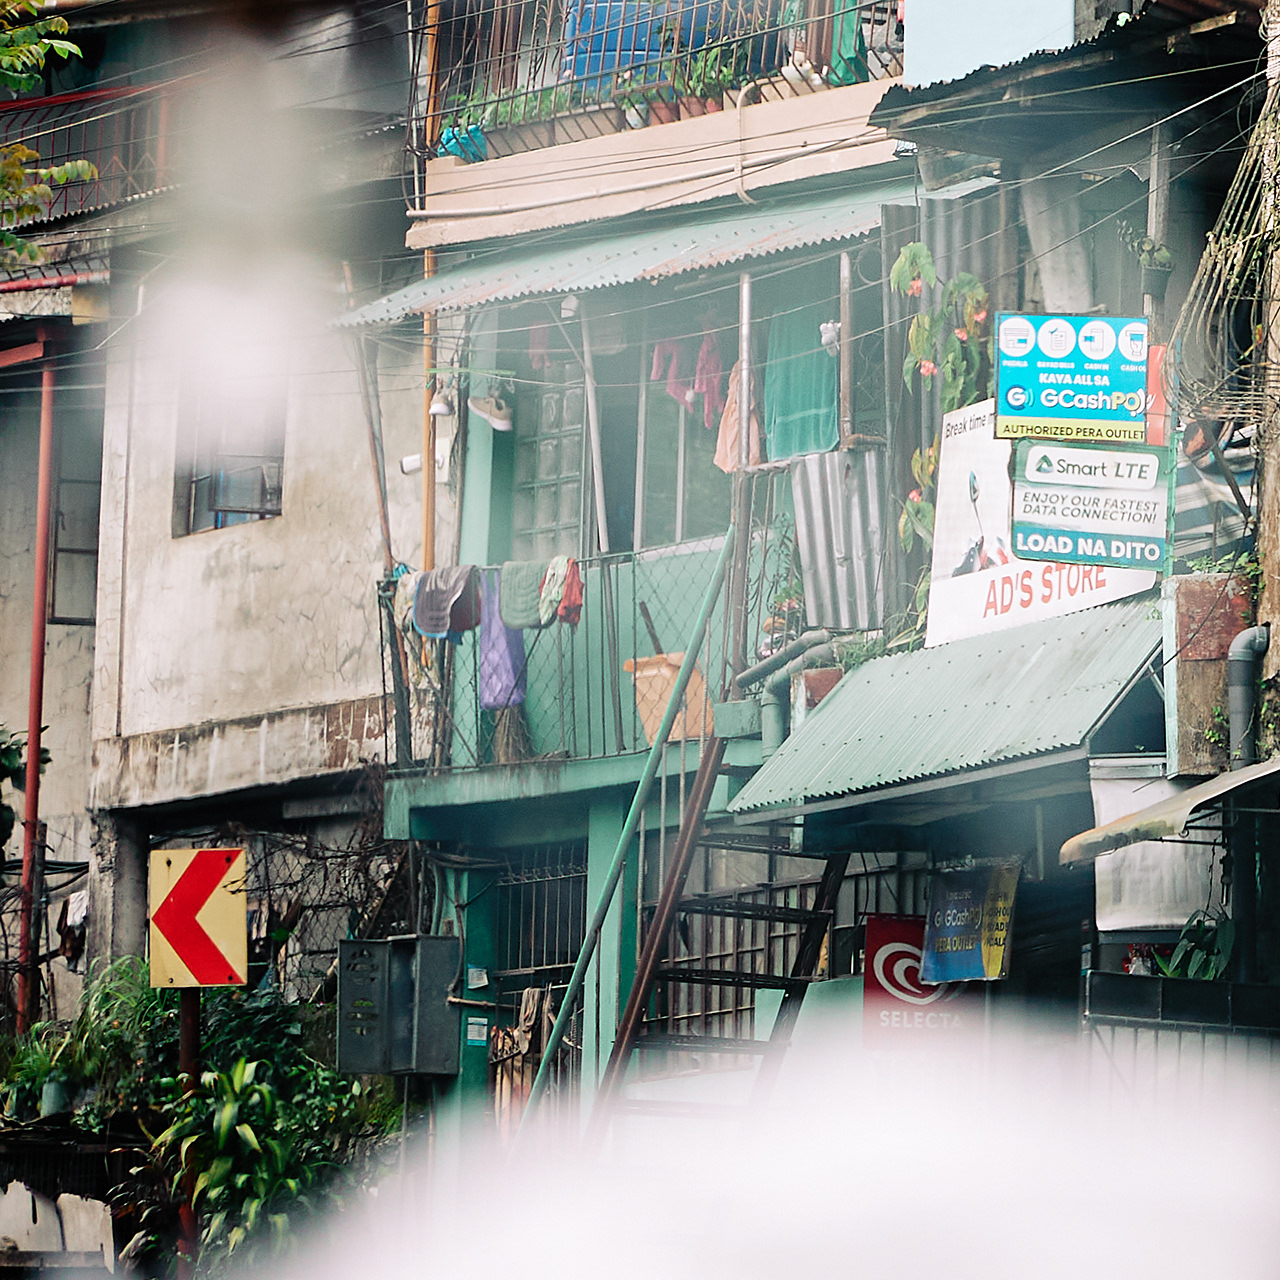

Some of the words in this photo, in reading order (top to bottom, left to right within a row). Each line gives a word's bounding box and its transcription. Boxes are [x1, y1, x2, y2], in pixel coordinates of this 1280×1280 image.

[1039, 373, 1073, 384] KAYA
[1074, 375, 1093, 385] ALL
[1094, 376, 1110, 386] SA
[945, 417, 968, 438] Break
[969, 414, 986, 431] time
[1003, 424, 1073, 436] AUTHORIZED
[1075, 427, 1103, 438] PERA
[1106, 428, 1145, 439] OUTLET
[1056, 458, 1107, 477] Smart
[1114, 462, 1150, 479] LTE
[1022, 492, 1068, 505] ENJOY
[1071, 495, 1101, 507] OUR
[1103, 498, 1160, 512] FASTEST
[1022, 504, 1057, 516] DATA
[1061, 506, 1157, 524] CONNECTION!
[1016, 533, 1073, 554] LOAD
[1077, 538, 1107, 557] NA
[1111, 540, 1160, 561] DITO
[983, 570, 1033, 618] AD'S
[1041, 563, 1106, 604] STORE
[880, 1010, 963, 1029] SELECTA
